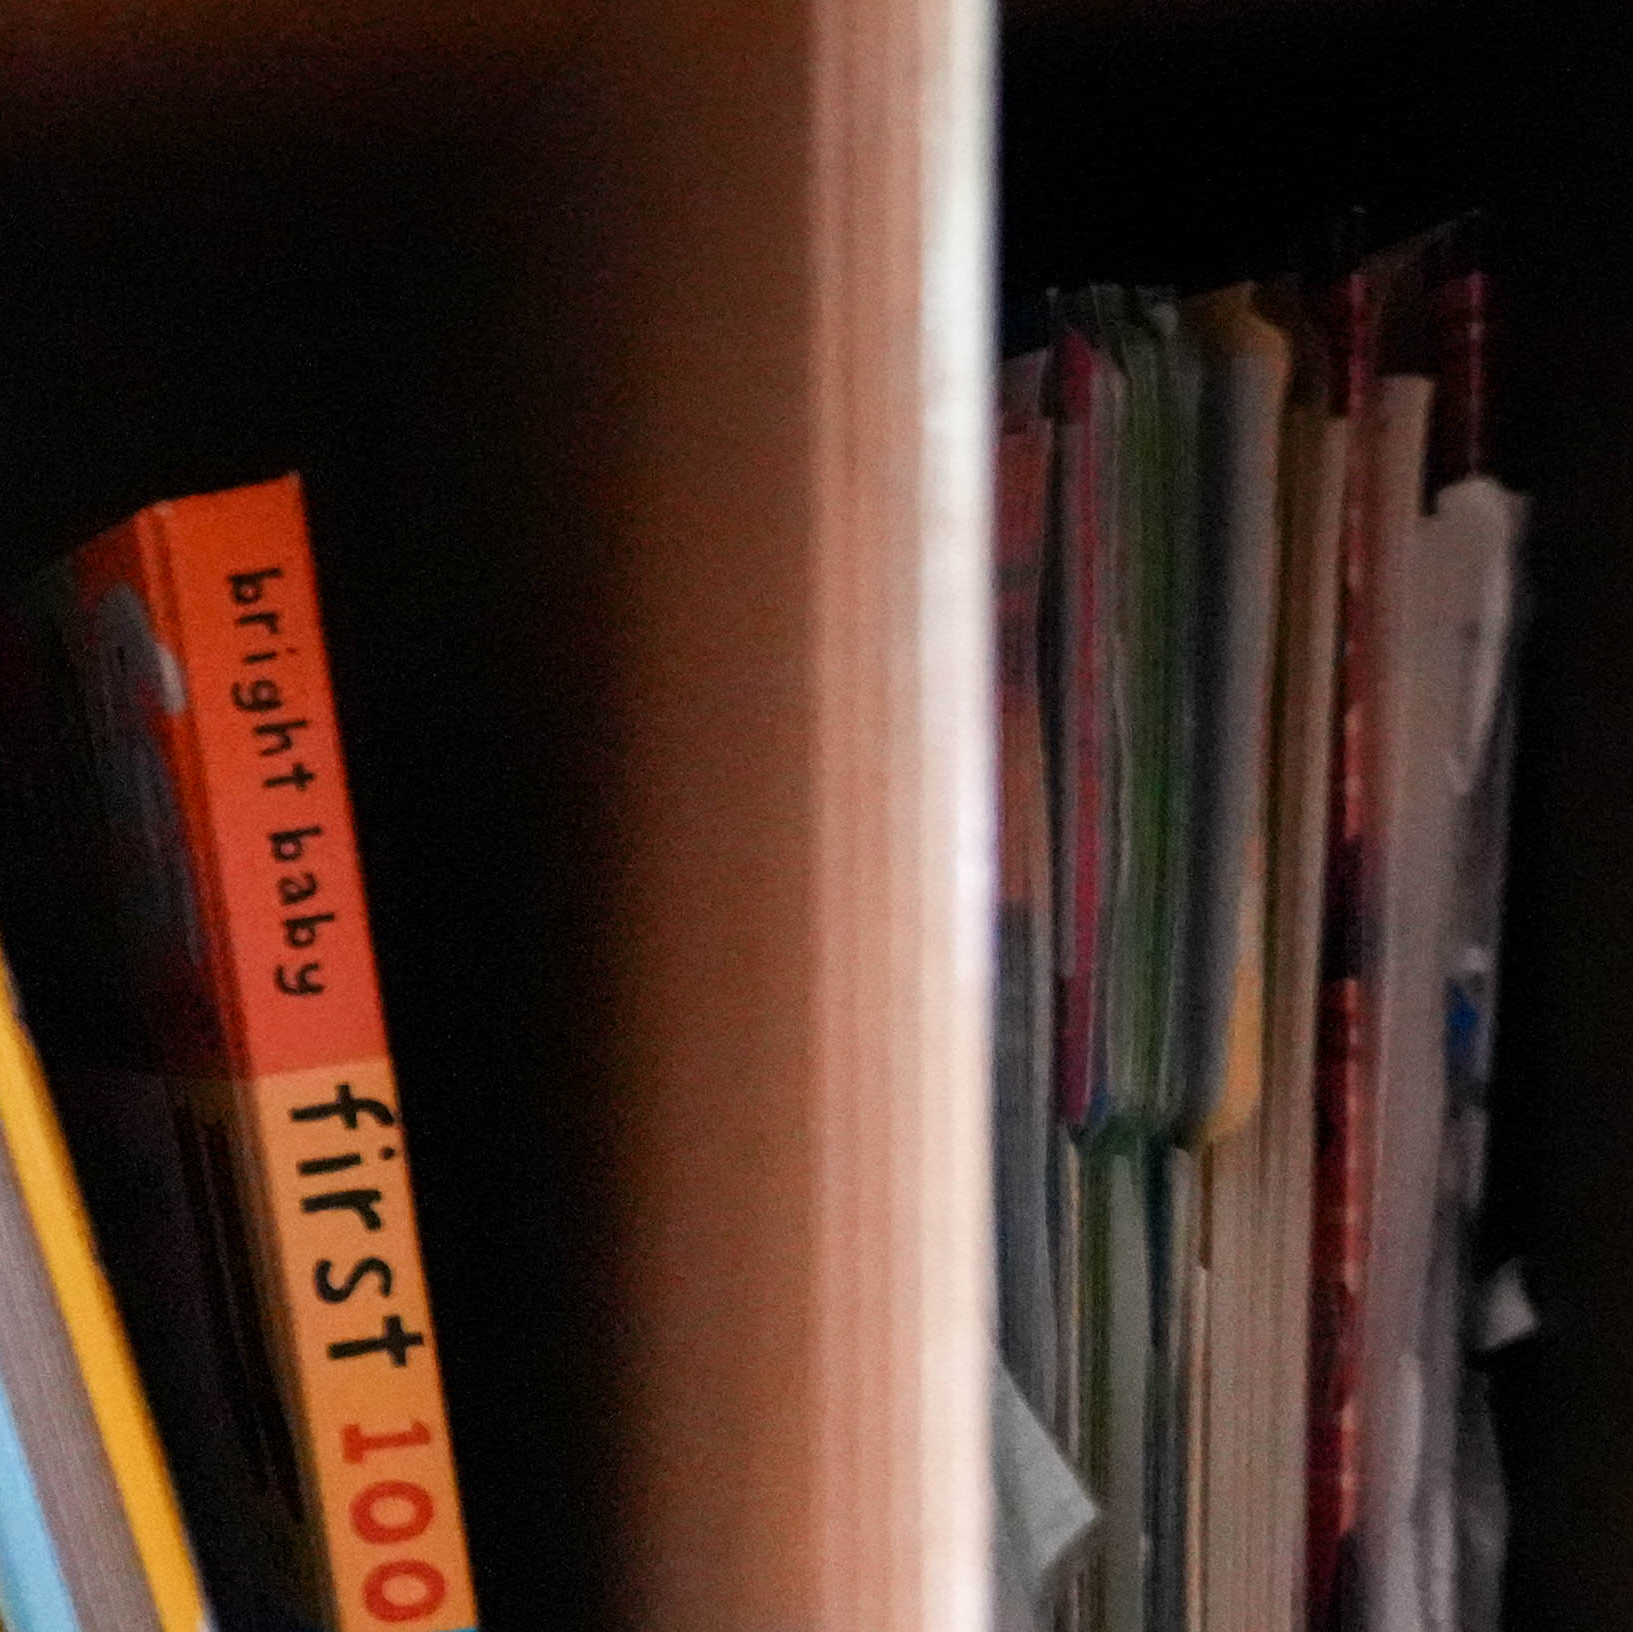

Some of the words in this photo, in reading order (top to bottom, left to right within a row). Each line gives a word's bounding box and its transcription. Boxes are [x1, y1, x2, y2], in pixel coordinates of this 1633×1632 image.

[213, 563, 319, 799] bright
[249, 824, 348, 1002] baby
[281, 1075, 433, 1379] first
[333, 1409, 460, 1629] 100
